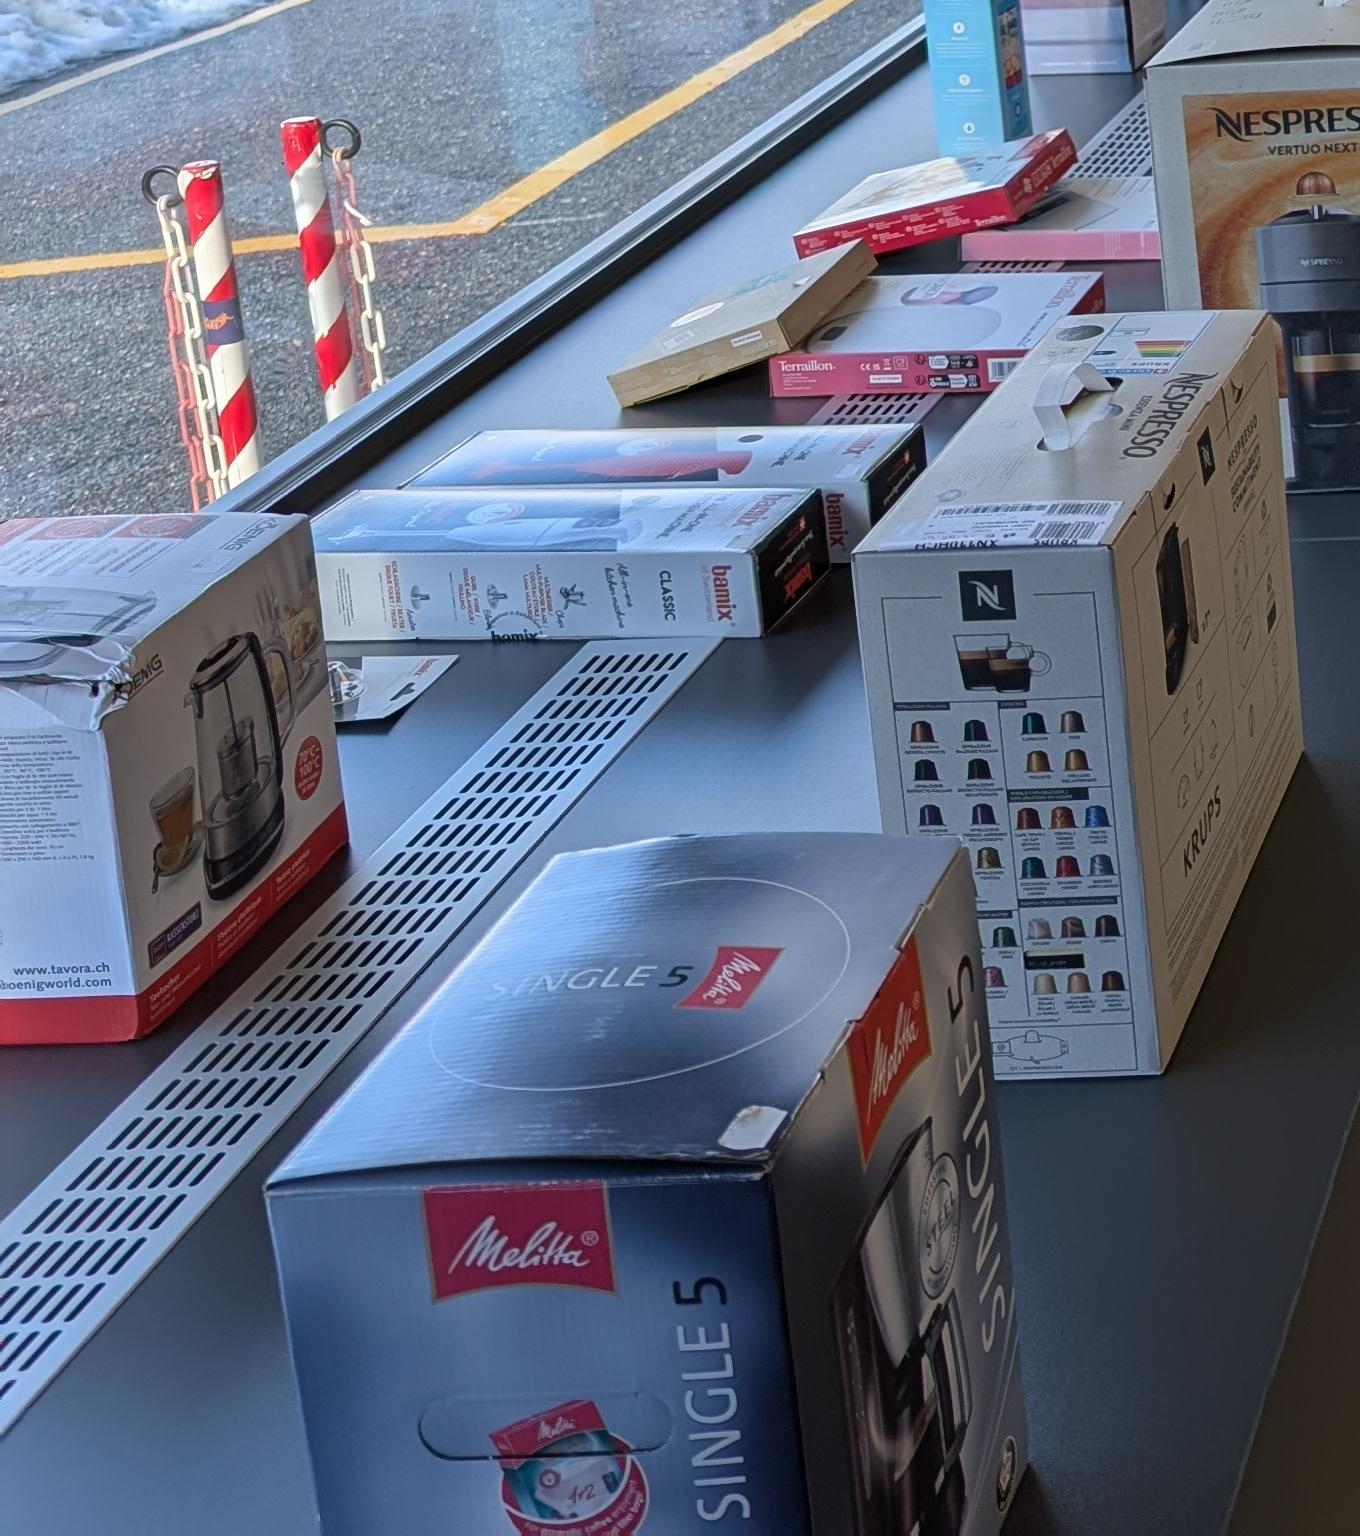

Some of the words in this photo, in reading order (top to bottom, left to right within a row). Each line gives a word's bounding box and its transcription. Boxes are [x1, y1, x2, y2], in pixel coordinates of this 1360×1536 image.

[1268, 144, 1320, 155] VERTUO
[1324, 142, 1358, 154] NEXT
[974, 215, 1007, 227] Terraillon
[778, 359, 833, 372] Terraillon
[1122, 372, 1218, 459] NESPRESSO
[826, 493, 844, 547] bamix
[659, 570, 676, 621] CLASSIC
[711, 565, 734, 622] bamix
[1183, 785, 1221, 878] KRUPS
[13, 962, 110, 975] www.tavora.ch
[658, 965, 694, 988] 5
[702, 950, 761, 1001] Melitta
[948, 955, 976, 1024] 5
[867, 1004, 920, 1125] Melitta
[955, 1020, 1006, 1353] SINGLE
[448, 1215, 591, 1275] Melitta
[925, 1197, 957, 1257] STEEL
[672, 1277, 727, 1305] 5
[538, 1417, 576, 1441] Melitta
[676, 1322, 751, 1521] SINGLE
